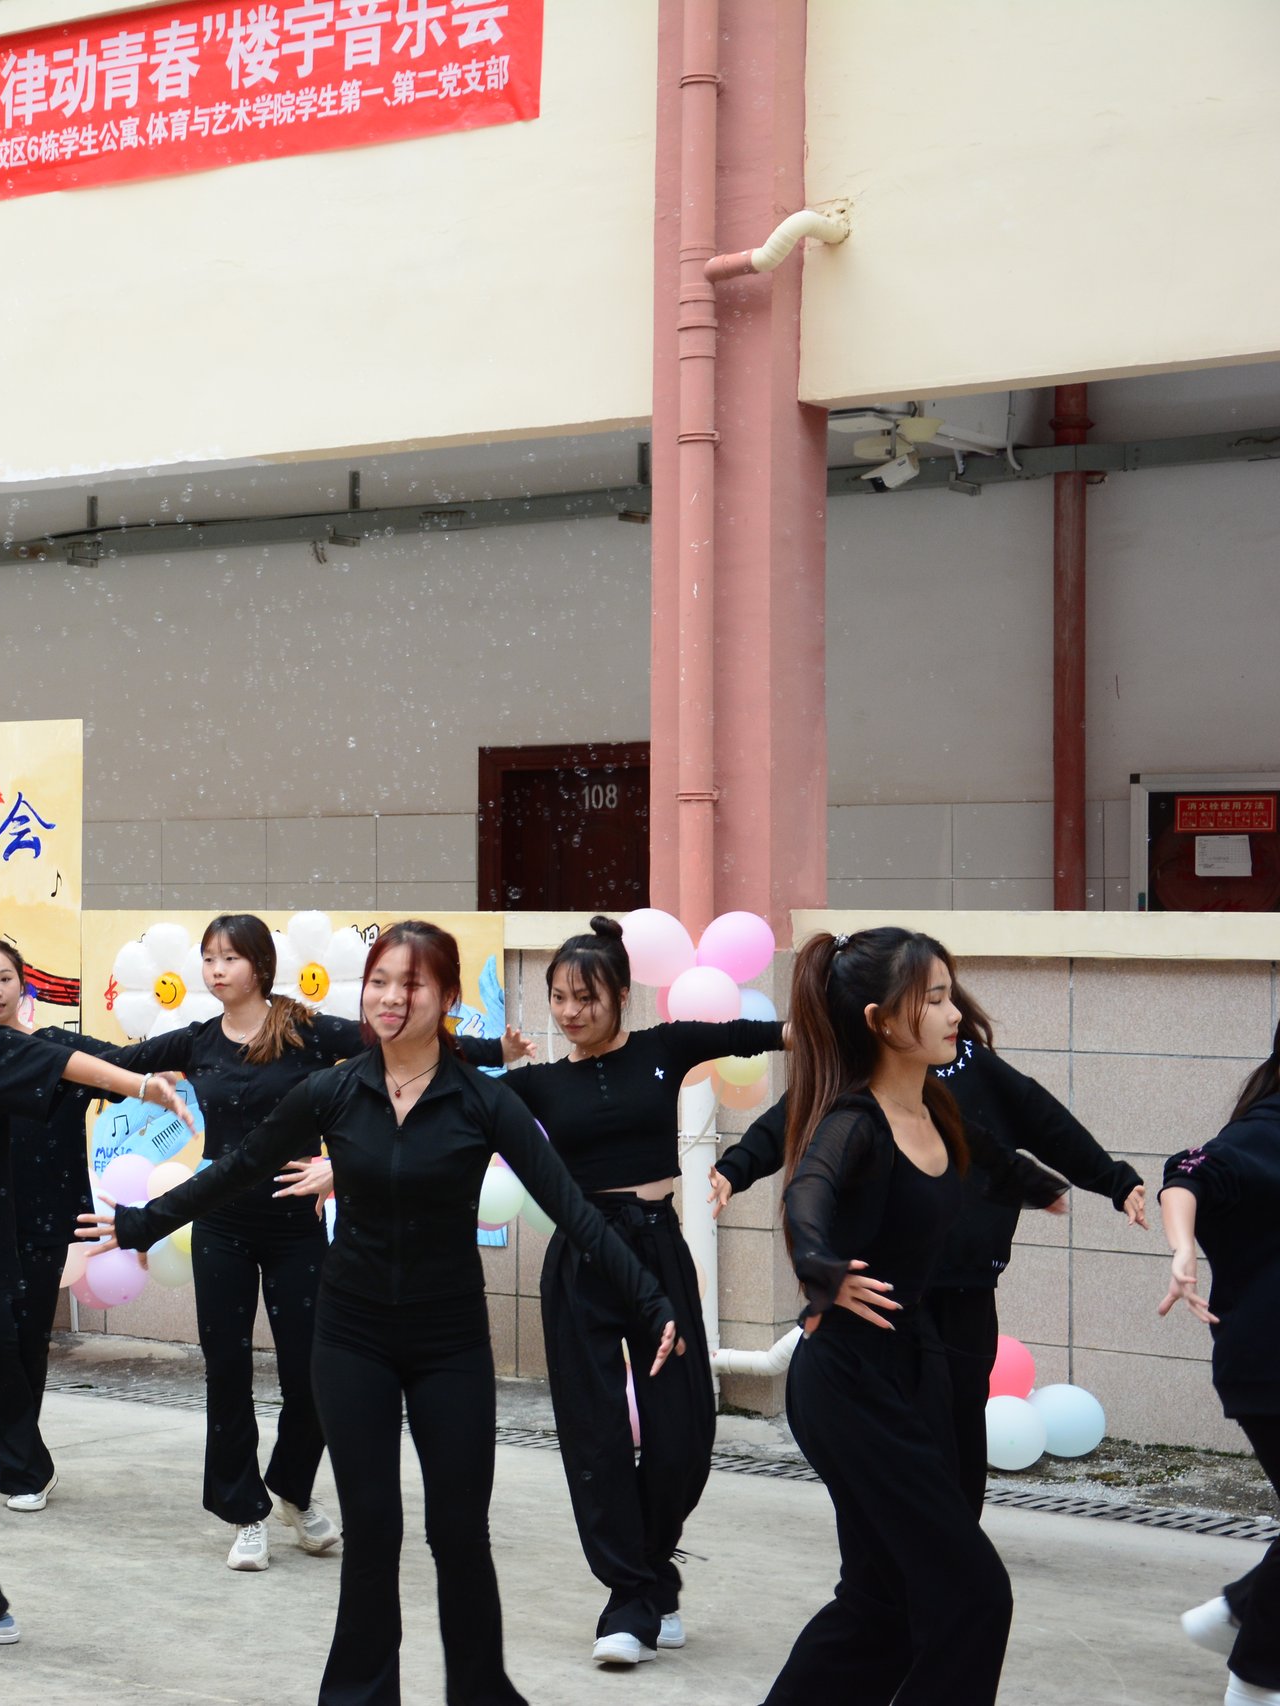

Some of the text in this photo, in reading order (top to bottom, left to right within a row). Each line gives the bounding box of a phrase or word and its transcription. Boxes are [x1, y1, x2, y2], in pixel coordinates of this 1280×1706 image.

[582, 784, 618, 810] 108
[1187, 801, 1265, 811] 消火栓使用方法
